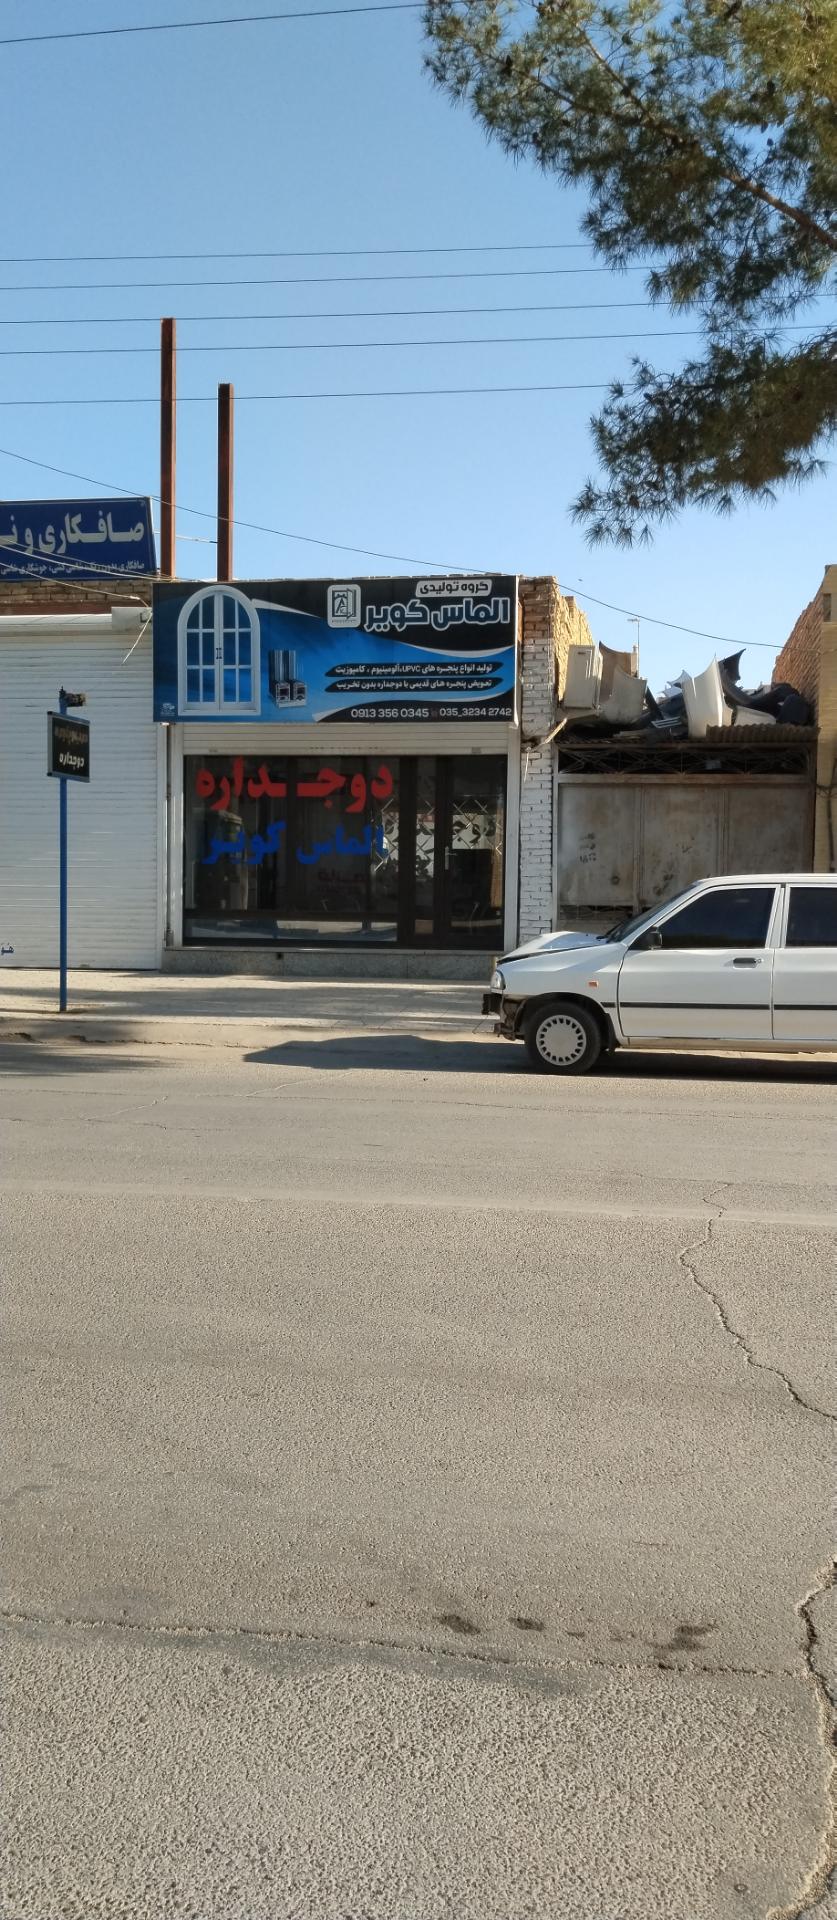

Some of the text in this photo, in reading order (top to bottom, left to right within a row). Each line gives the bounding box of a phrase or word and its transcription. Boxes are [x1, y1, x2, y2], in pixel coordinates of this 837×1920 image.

[38, 510, 146, 554] صافکاری
[419, 581, 460, 595] تولیدی
[363, 597, 511, 633] الماس کویر
[421, 664, 436, 674] های
[436, 664, 458, 674] پنجره
[459, 664, 475, 674] انواع
[476, 663, 493, 674] تولید
[336, 681, 360, 690] تخریب
[361, 681, 377, 690] بدون
[409, 680, 430, 690] قدیمی
[430, 680, 445, 689] های
[446, 681, 467, 690] پنجره
[467, 680, 493, 689] تعویض
[350, 708, 377, 718] 0913
[378, 708, 399, 718] 356
[400, 708, 430, 718] 0345
[488, 707, 512, 716] 2742
[59, 751, 85, 770] دوجداره
[201, 820, 389, 865] الماس کویر
